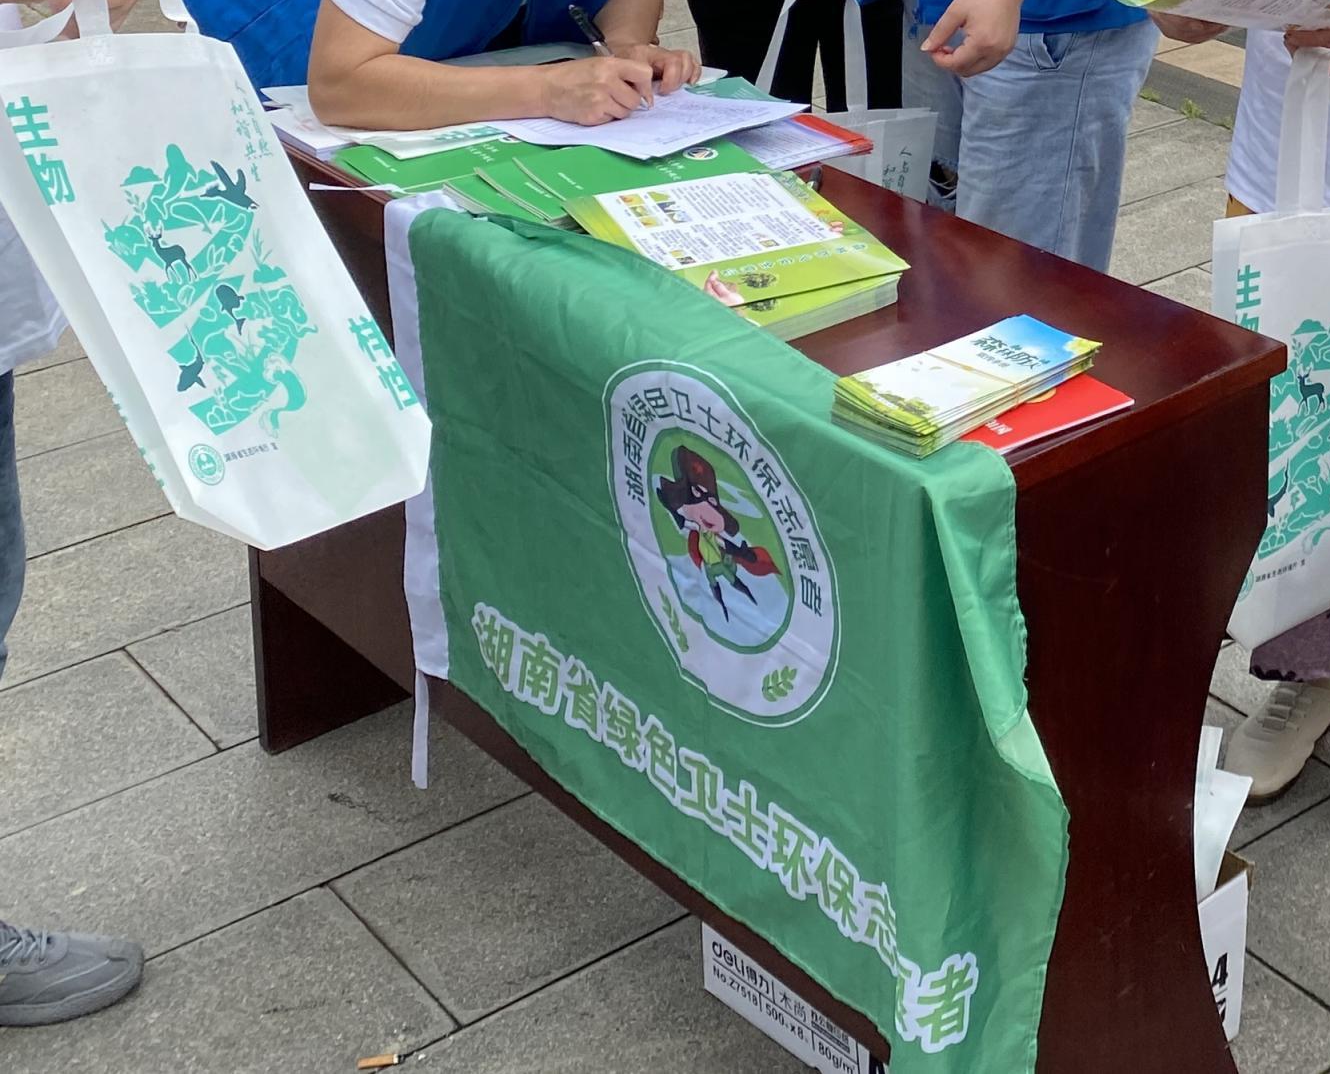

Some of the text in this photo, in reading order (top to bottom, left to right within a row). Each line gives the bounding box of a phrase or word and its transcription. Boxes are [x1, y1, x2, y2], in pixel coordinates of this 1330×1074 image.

[5, 95, 75, 206] 生物
[622, 386, 823, 618] 湖南省绿色卫士环保志愿者
[474, 606, 977, 1048] 湖南省绿色卫士环保志者
